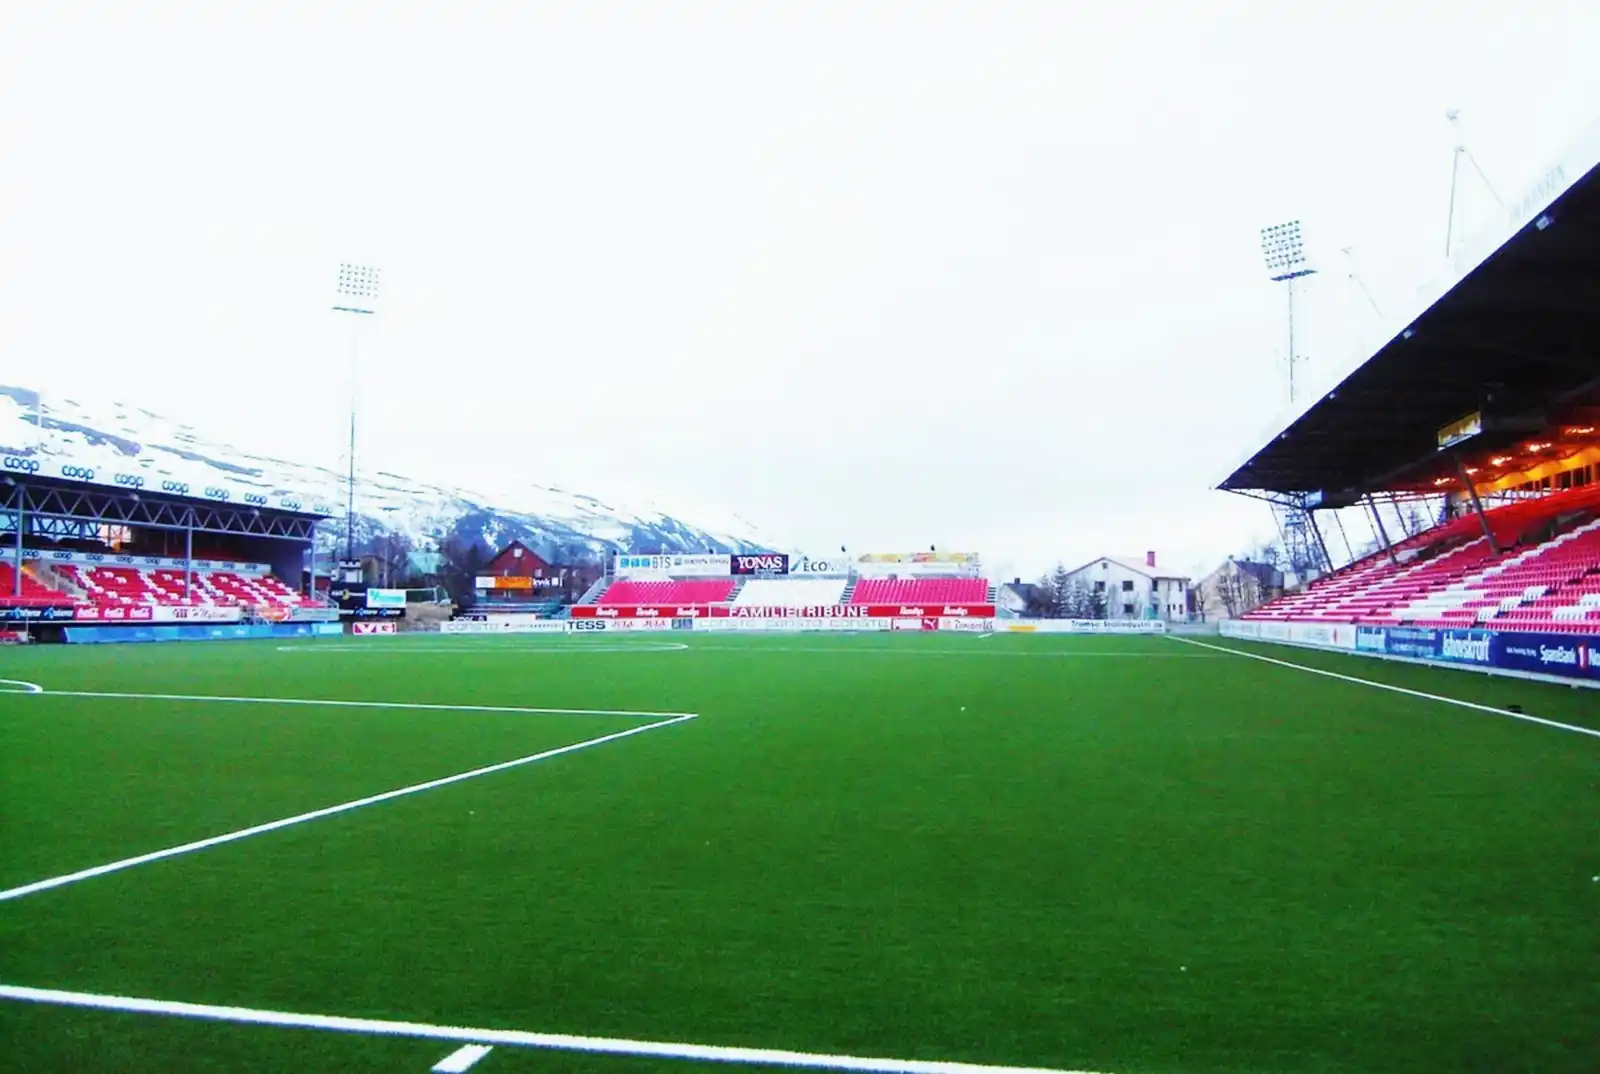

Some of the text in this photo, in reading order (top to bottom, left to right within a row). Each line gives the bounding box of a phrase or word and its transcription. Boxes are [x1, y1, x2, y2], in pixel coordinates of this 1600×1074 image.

[4, 457, 39, 474] coop
[62, 465, 94, 482] coop
[115, 473, 144, 491] coop
[737, 556, 783, 569] YONAS
[729, 606, 869, 617] FAMILIETRIBUNE
[567, 620, 606, 630] TESS
